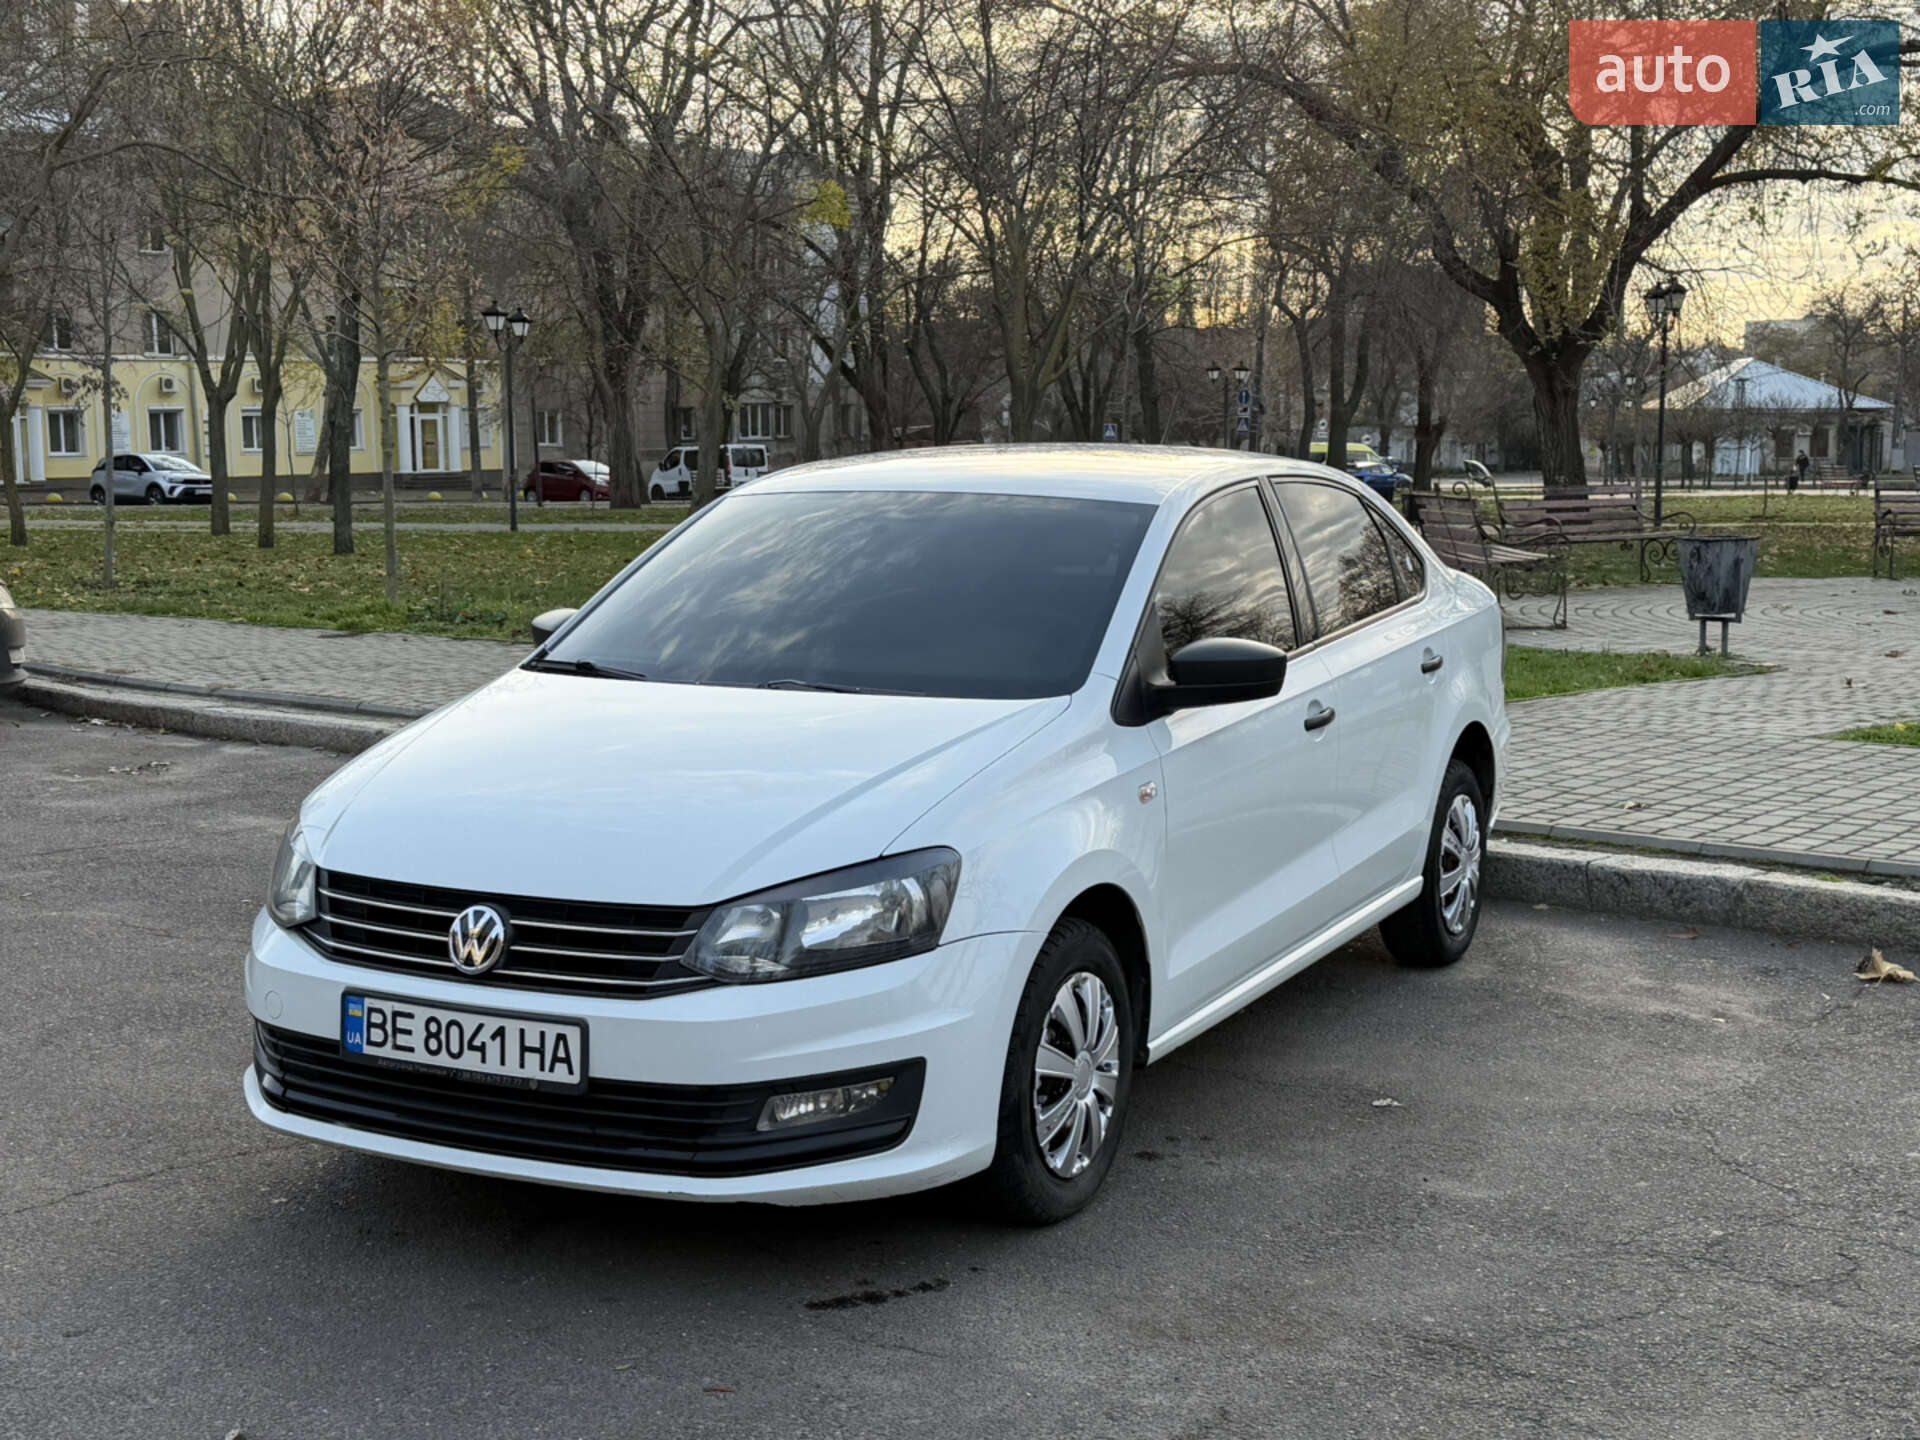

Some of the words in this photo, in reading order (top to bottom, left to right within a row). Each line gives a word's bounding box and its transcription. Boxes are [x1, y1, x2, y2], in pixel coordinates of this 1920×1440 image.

[347, 1030, 362, 1045] UA
[366, 1005, 415, 1054] BE
[424, 1015, 506, 1067] 8041
[519, 1027, 574, 1076] HA
